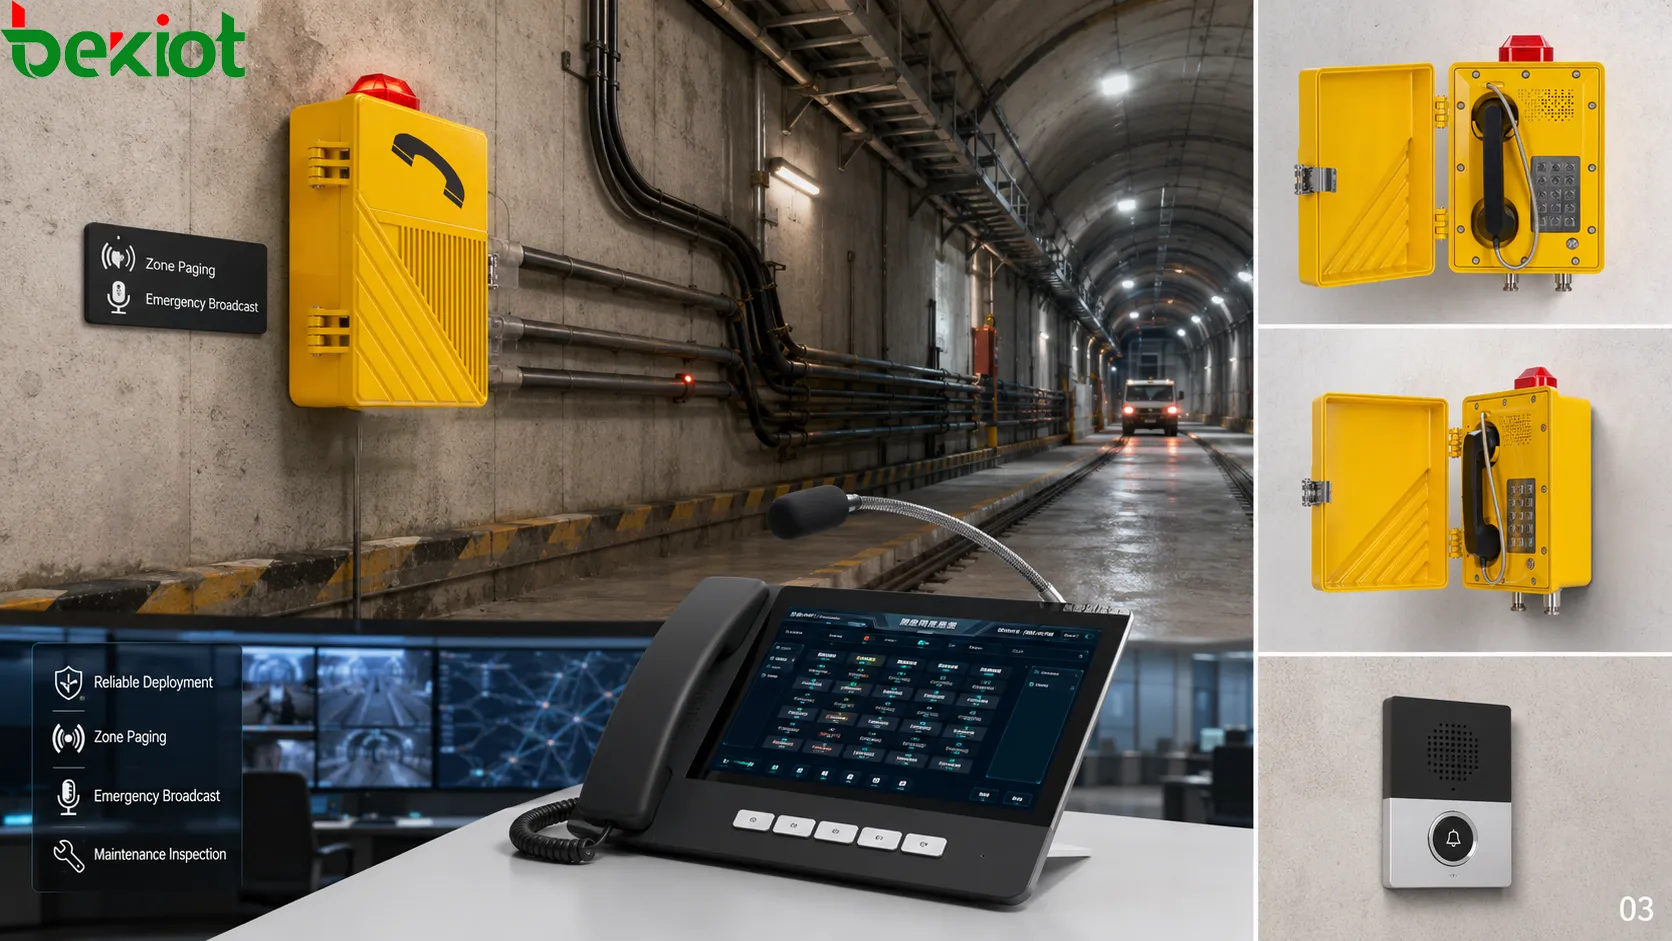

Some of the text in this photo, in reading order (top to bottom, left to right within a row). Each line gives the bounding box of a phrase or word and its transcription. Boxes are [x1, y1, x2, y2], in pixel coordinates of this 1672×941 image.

[146, 257, 216, 279] Zone Paging
[146, 293, 259, 313] Emergency Broadcast
